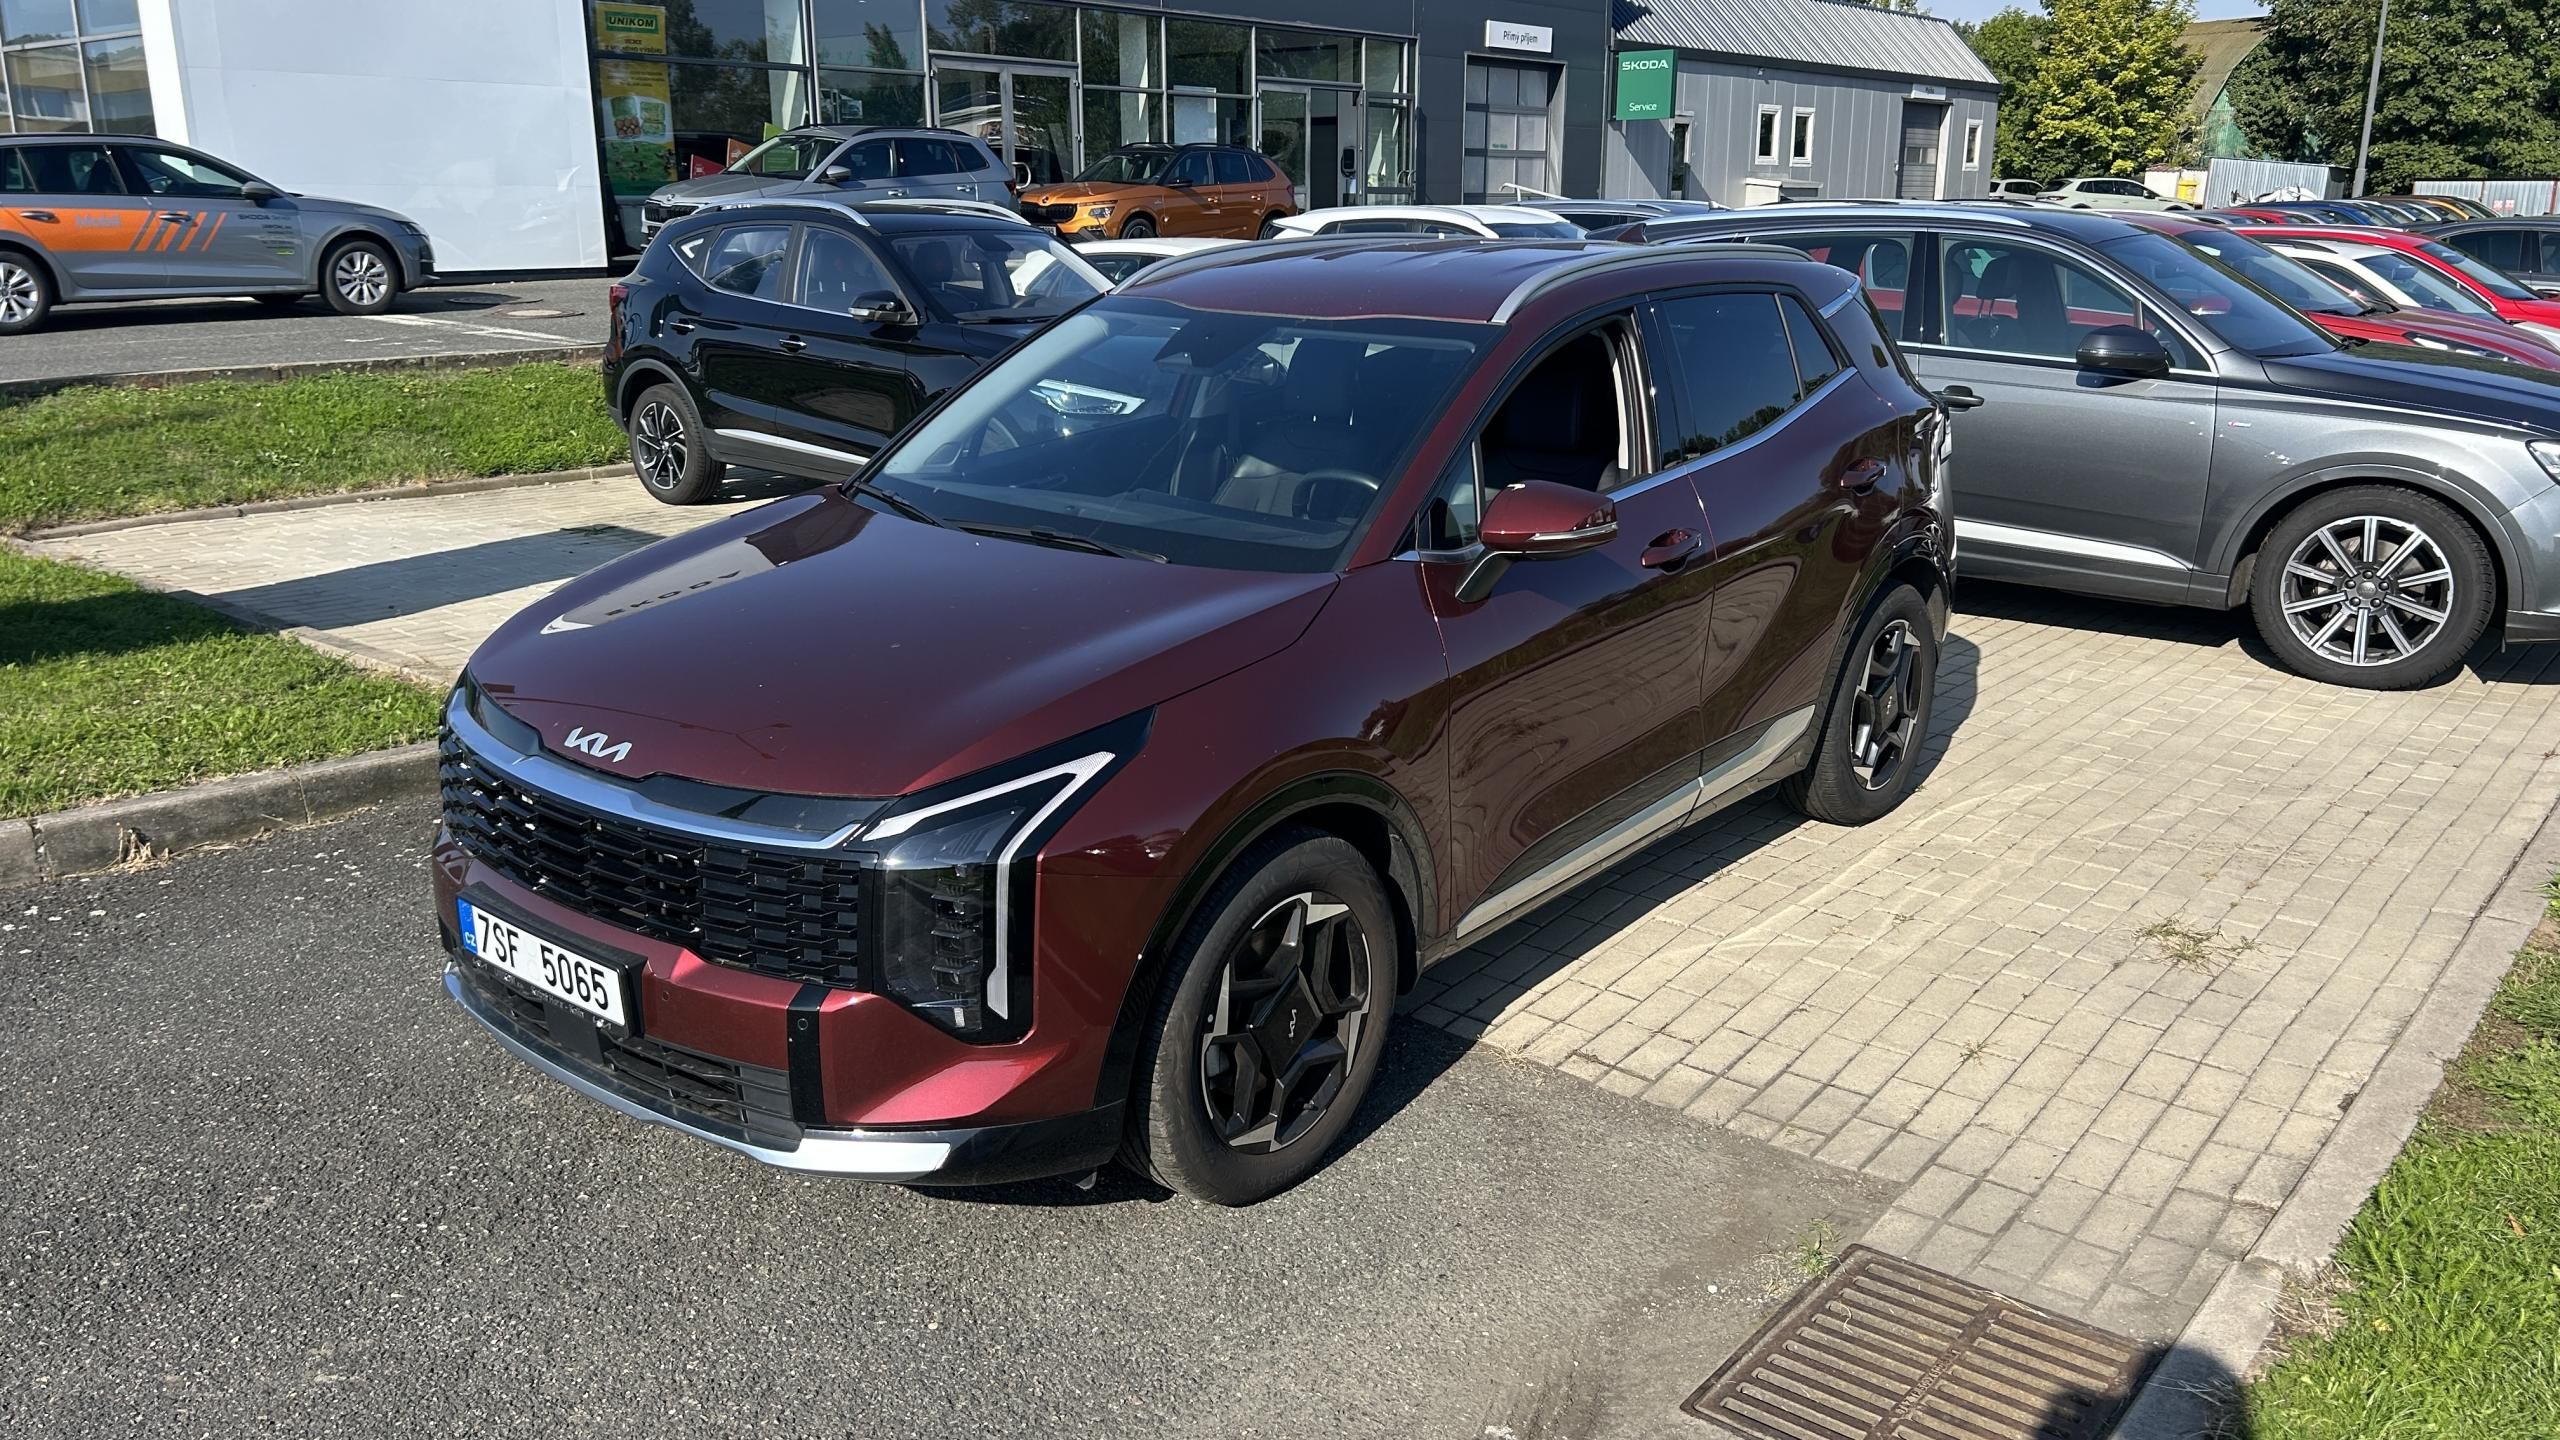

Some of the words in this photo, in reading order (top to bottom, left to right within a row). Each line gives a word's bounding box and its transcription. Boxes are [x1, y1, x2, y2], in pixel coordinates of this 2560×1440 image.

[608, 16, 655, 28] UNIKOM
[1629, 102, 1657, 112] Service
[464, 931, 477, 947] CZ
[477, 913, 520, 968] 7SF
[540, 943, 610, 1011] 5065
